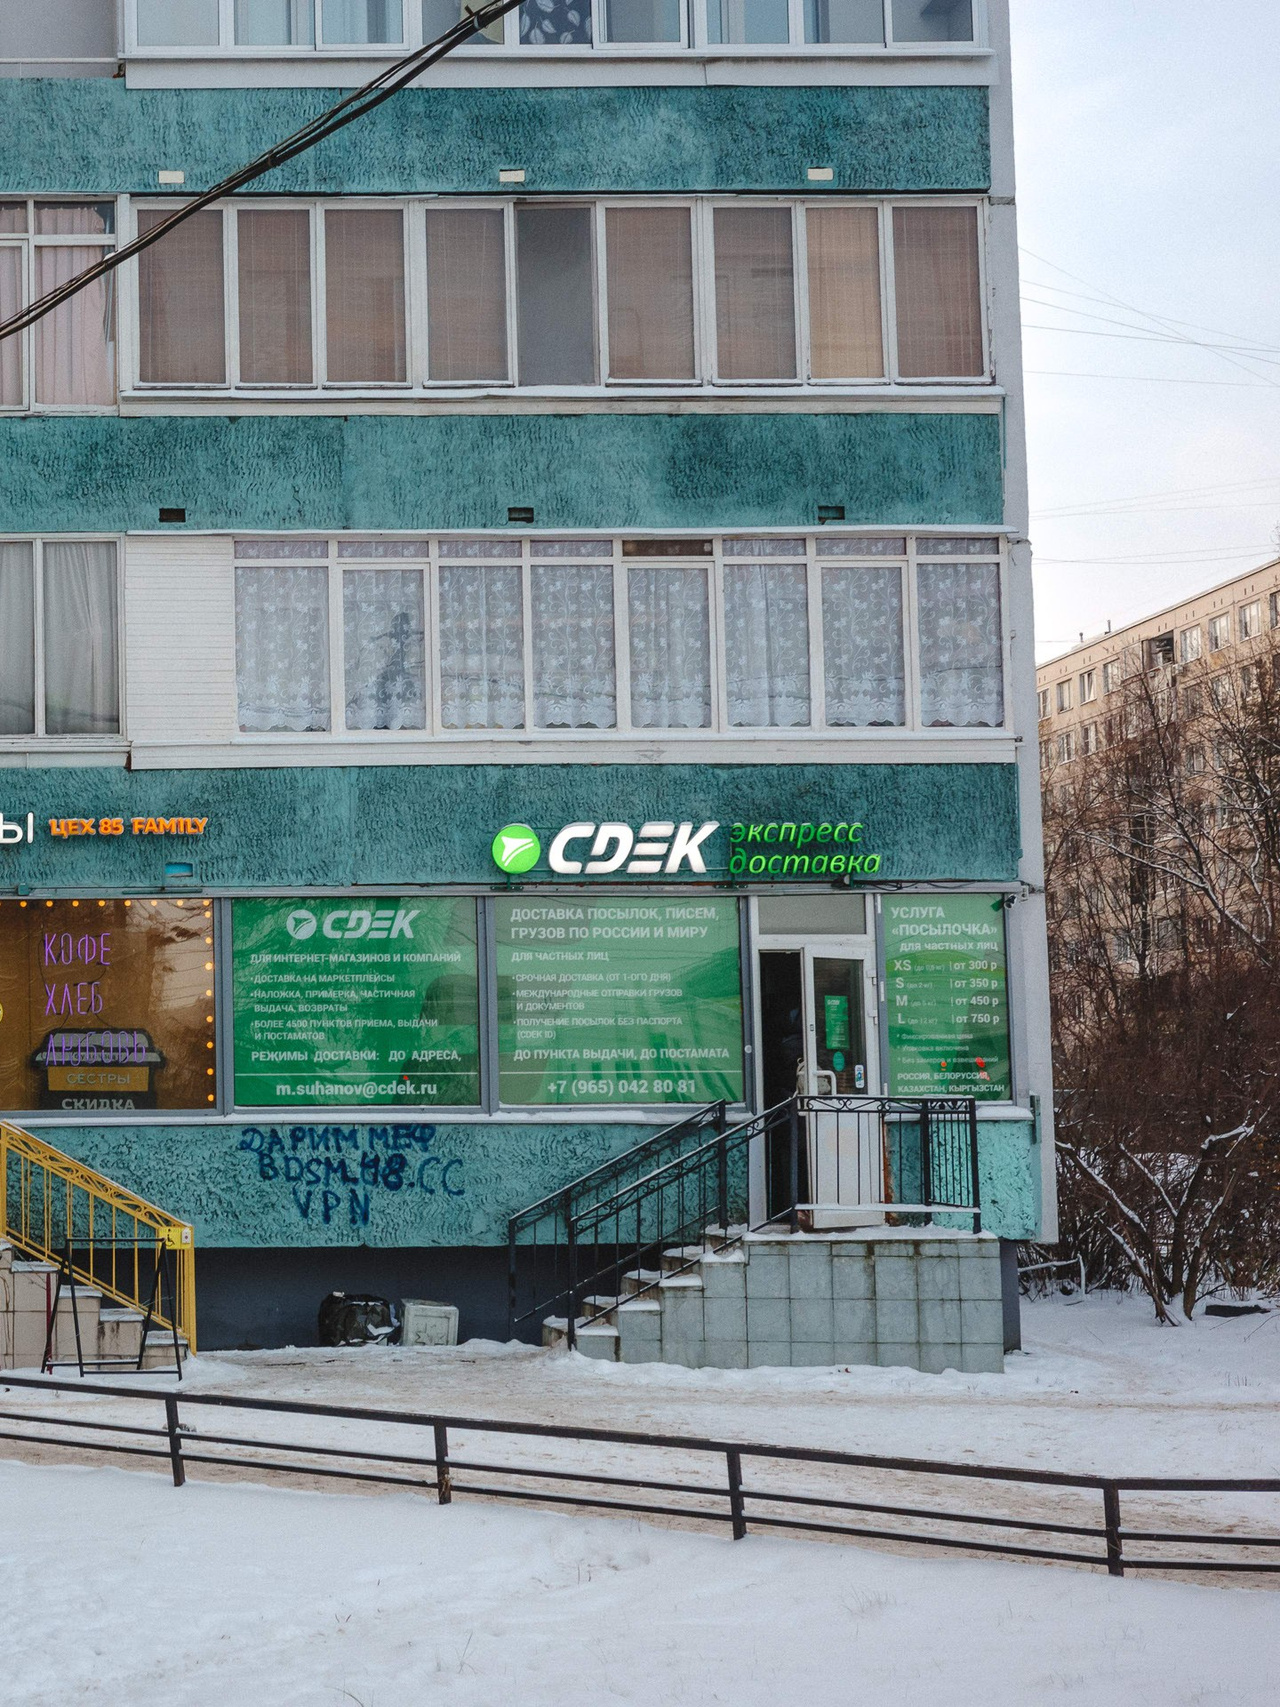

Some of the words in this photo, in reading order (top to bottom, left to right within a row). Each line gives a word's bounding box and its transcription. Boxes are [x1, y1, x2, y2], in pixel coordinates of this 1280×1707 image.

[49, 818, 96, 839] ЦЕХ
[98, 817, 124, 835] 85
[131, 816, 208, 835] FAMILY
[729, 822, 864, 848] экспресс
[548, 821, 720, 874] CDEK
[729, 848, 881, 875] доставка
[510, 908, 584, 922] ДОСТАВКА
[588, 908, 662, 921] ПОСЫЛОК,
[666, 907, 719, 921] ПИСЕМ,
[891, 907, 945, 918] УСЛУГА
[323, 910, 420, 939] CDEK
[892, 924, 997, 936] «ПОСЫЛОЧКА»
[511, 928, 565, 939] ГРУЗОВ
[569, 928, 589, 938] ПО
[593, 927, 650, 938] РОССИИ
[654, 927, 663, 937] И
[668, 927, 707, 938] МИРУ
[44, 933, 111, 966] КОФЕ
[900, 942, 921, 952] для
[924, 942, 973, 951] частных
[977, 941, 998, 951] лиц
[251, 954, 271, 964] ДЛЯ
[274, 954, 390, 963] ИНТЕРНЕТ-МАГАЗИНОВ
[393, 954, 400, 962] И
[403, 951, 461, 962] КОМПАНИЙ
[512, 953, 533, 963] ДЛЯ
[536, 952, 584, 961] ЧАСТНЫХ
[587, 952, 609, 962] ЛИЦ
[895, 960, 911, 971] XS
[954, 962, 966, 970] от
[969, 961, 988, 969] 300
[991, 962, 997, 971] р
[254, 975, 301, 983] ДОСТАВКА
[319, 973, 395, 982] МАРКЕТПЛЕЙСЫ
[516, 974, 556, 982] СРОЧНАЯ
[559, 974, 603, 983] ДОСТАВКА
[606, 974, 620, 982] (ОТ
[650, 974, 671, 982] ДНЯ)
[896, 977, 904, 988] S
[970, 979, 988, 987] 350
[992, 980, 997, 989] р
[45, 981, 103, 1016] ХЛЕБ
[254, 990, 301, 999] НАЛОЖКА,
[305, 990, 358, 998] ПРИМЕРКА,
[360, 990, 415, 998] ЧАСТИЧНАЯ
[516, 989, 599, 998] МЕЖДУНАРОДНЫЕ
[601, 989, 647, 997] ОТПРАВКИ
[525, 1003, 584, 1011] ДОКУМЕНТОВ
[896, 995, 907, 1006] M
[970, 996, 989, 1005] 450
[992, 998, 999, 1007] р
[254, 1004, 296, 1013] ВЫДАЧА,
[299, 1004, 348, 1012] ВОЗВРАТЫ
[254, 1020, 284, 1028] БОЛЕЕ
[286, 1020, 307, 1028] 4500
[310, 1020, 352, 1028] ПУНКТОВ
[355, 1020, 395, 1028] ПРИЕМА,
[398, 1019, 437, 1028] ВЫДАЧИ
[517, 1018, 569, 1026] ПОЛУЧЕНИЕ
[572, 1018, 615, 1026] ПОСЫЛОК
[898, 1013, 905, 1024] L
[971, 1014, 990, 1022] 750
[993, 1016, 999, 1024] р
[263, 1032, 325, 1040] ПОСТАМАТОВ
[518, 1030, 542, 1039] (CDEK
[45, 1031, 146, 1066] ЛЮБОВЬ
[251, 1052, 308, 1061] РЕЖИМЫ
[314, 1051, 379, 1062] ДОСТАВКИ:
[389, 1051, 406, 1062] ДО
[412, 1050, 461, 1062] АДРЕСА,
[514, 1051, 531, 1061] ДО
[535, 1050, 580, 1059] ПУНКТА
[583, 1050, 637, 1060] ВЫДАЧИ,
[640, 1049, 657, 1060] ДО
[660, 1049, 729, 1059] ПОСТАМАТА
[66, 1073, 130, 1085] СЕСТРЫ
[934, 1072, 988, 1080] БЕЛОРУССИЯ,
[276, 1081, 437, 1098] m.suhanov@cdek.ru
[548, 1081, 566, 1093] +7
[572, 1080, 613, 1096] (965)
[618, 1080, 649, 1094] 042
[654, 1080, 672, 1093] 80
[678, 1080, 695, 1092] 81
[898, 1085, 947, 1093] КАЗАХСТАН,
[61, 1098, 136, 1110] СКИДКА
[292, 1184, 370, 1225] VPN
